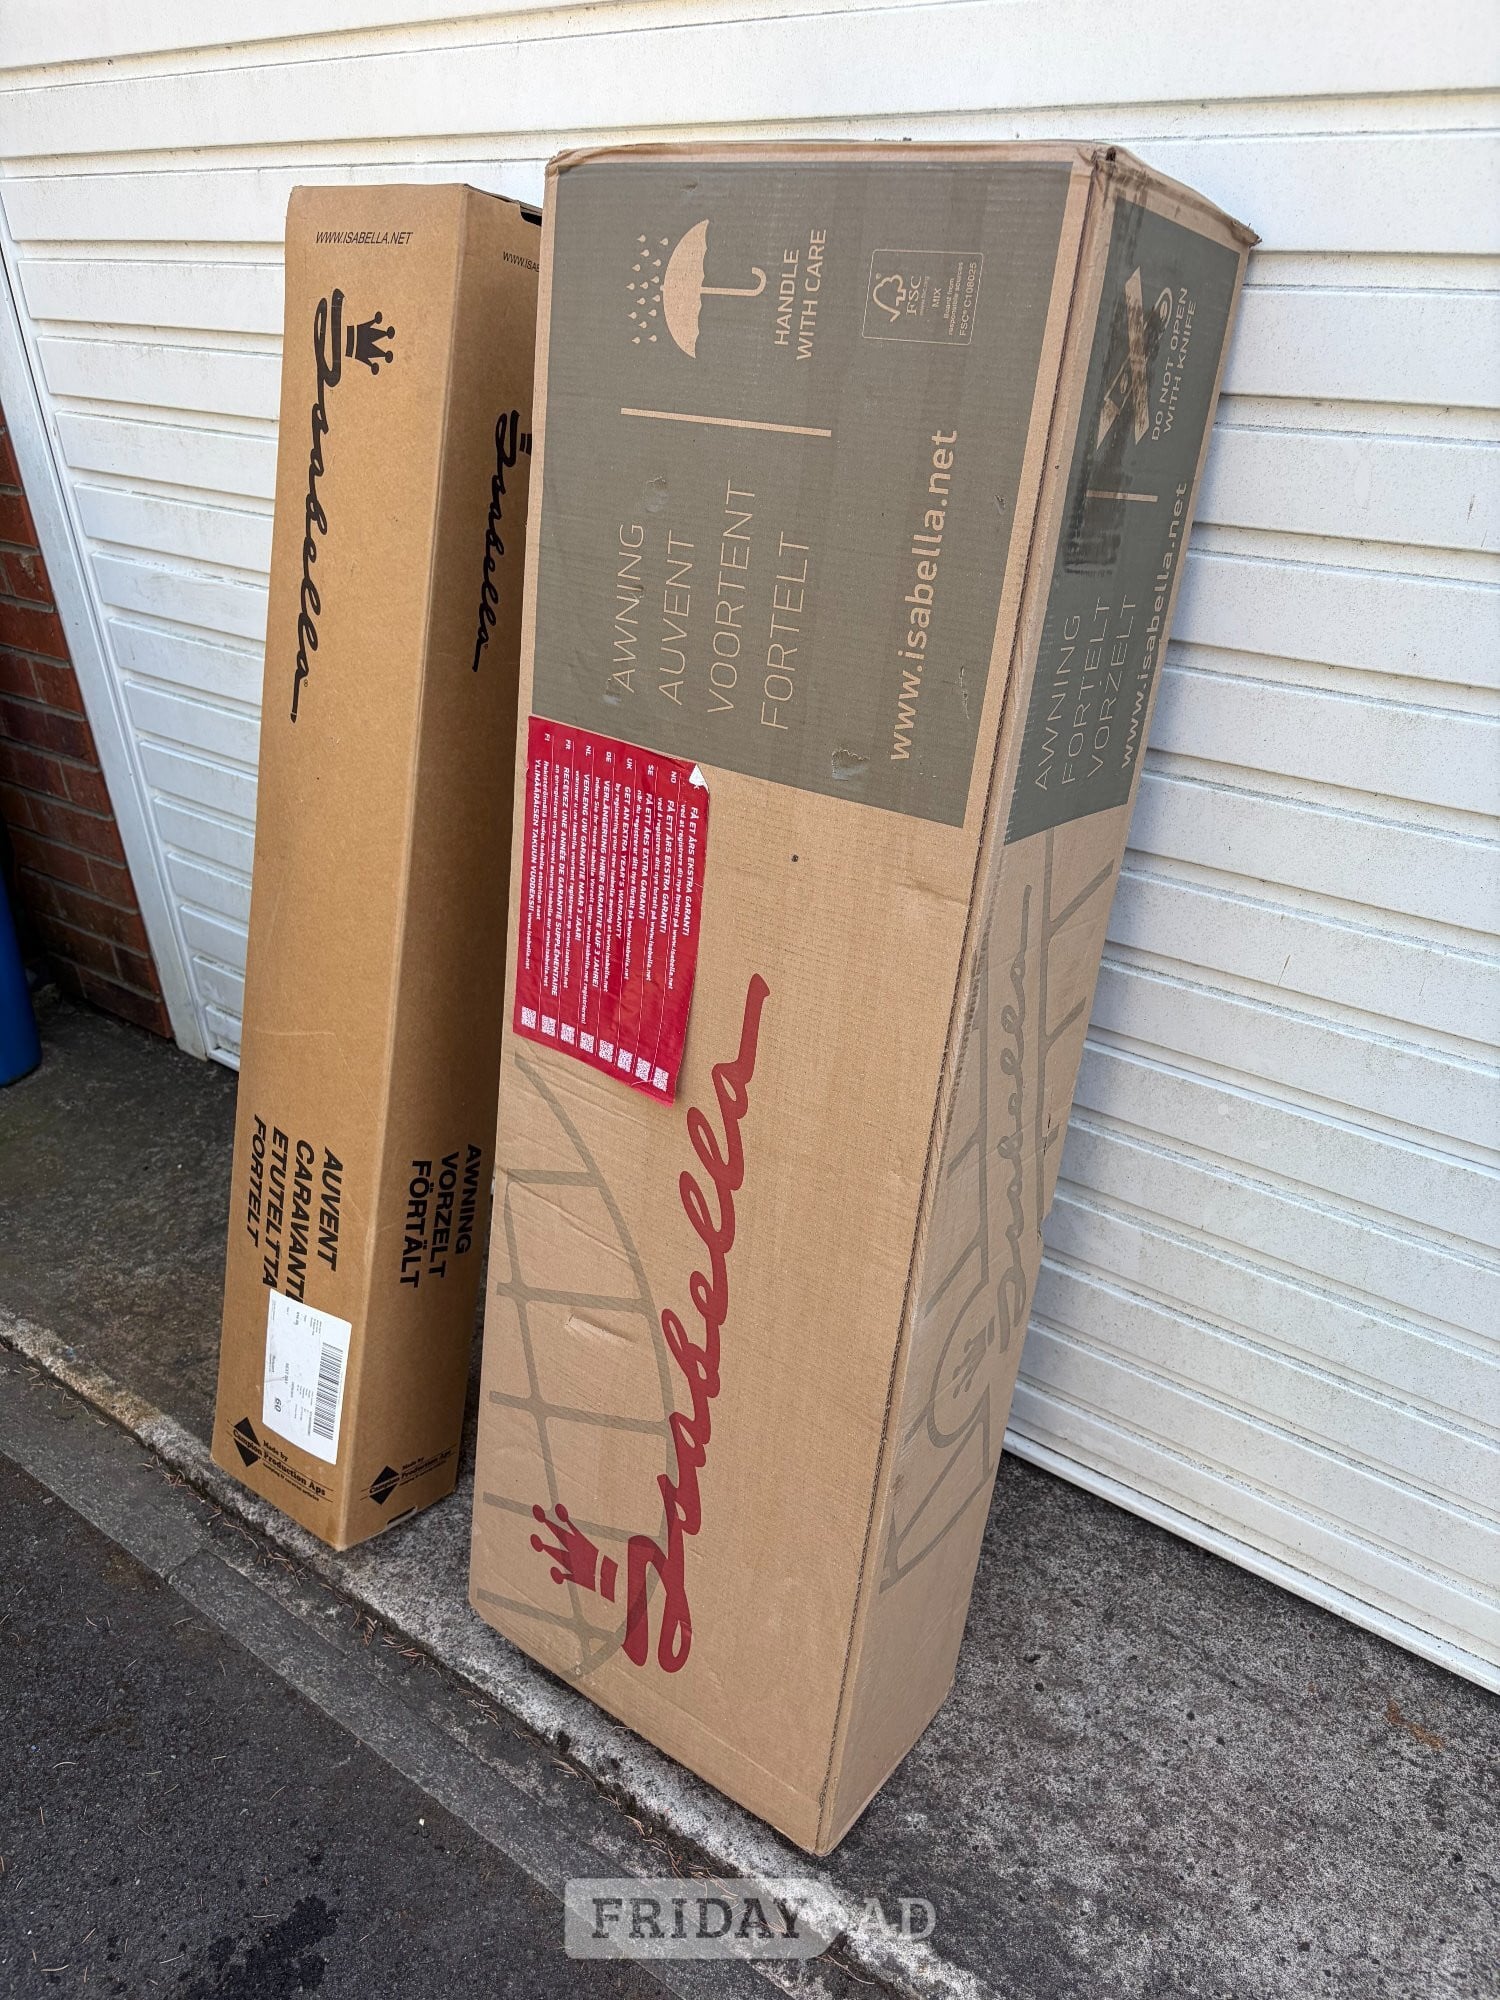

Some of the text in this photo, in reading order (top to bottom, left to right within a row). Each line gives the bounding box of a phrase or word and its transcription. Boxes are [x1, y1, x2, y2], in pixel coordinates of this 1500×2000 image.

[315, 231, 414, 245] WWW.ISABELLA.NET
[774, 249, 800, 346] HANDLE
[797, 228, 828, 361] WITH CARE
[906, 275, 922, 317] FSC
[931, 287, 941, 309] MIX
[963, 261, 977, 309] C108025
[1151, 287, 1188, 441] DO NOT OPEN
[1163, 301, 1196, 433] WITH KNIFE
[290, 288, 345, 724] Isabella
[473, 410, 523, 673] Isabella
[613, 523, 645, 694] AWNING
[658, 529, 696, 707] AUVENT
[707, 479, 756, 714] VOORTENT
[890, 429, 958, 761] www.isabella.net
[760, 531, 810, 731] FORTELT
[1121, 481, 1188, 770] www.isabella.net
[1035, 614, 1082, 791] AWNING
[1061, 596, 1111, 785] FORTELT
[1087, 594, 1136, 779] VORZELT
[544, 733, 550, 741] FI
[565, 739, 571, 750] FR
[585, 745, 591, 756] NL
[605, 751, 611, 763] DE
[626, 757, 632, 770] UK
[532, 759, 541, 826] YLIMÄÄRÄISEN
[581, 774, 590, 815] VERLENG
[614, 782, 621, 792] by
[645, 792, 653, 805] FÅ
[647, 764, 654, 776] SE
[670, 770, 677, 783] NO
[581, 817, 588, 834] UW
[600, 780, 610, 853] VERLÄNGERUNG
[621, 822, 629, 851] EXTRA
[623, 805, 630, 820] AN
[642, 826, 651, 846] ÅRS
[679, 819, 685, 828] at
[558, 862, 565, 875] DE
[559, 830, 567, 861] ANNÉE
[578, 835, 587, 880] GARANTIE
[598, 855, 606, 883] IHRER
[618, 855, 626, 887] YEAR'S
[641, 847, 649, 877] EXTRA
[659, 799, 675, 933] FÅ ETT ÅRS EKSTRA GARANTI
[682, 806, 699, 935] FÅ ET ÅRS EKSTRA GARANTI
[555, 876, 564, 920] GARANTIE
[595, 884, 604, 928] GARANTIE
[615, 889, 624, 938] WARRANTY
[638, 879, 647, 919] GARANTI
[583, 924, 591, 982] www.isabella.net
[607, 924, 612, 933] at
[624, 920, 632, 979] www.isabella.net
[646, 921, 655, 981] www.isabella.net
[551, 921, 561, 996] SUPPLÉMENTAIRE
[603, 934, 611, 992] www.isabella.net
[668, 929, 677, 989] www.isabella.net
[246, 1114, 267, 1248] FORTELT
[263, 1126, 289, 1291] ETUTELTTA
[317, 1147, 344, 1272] AUVENT
[455, 1144, 482, 1255] AWNING
[400, 1160, 433, 1289] FÖRTÄLT
[428, 1152, 460, 1279] VORZELT
[622, 972, 771, 1674] Isabella
[274, 1397, 281, 1413] 60
[233, 1429, 326, 1496] Campion Production Aps
[263, 1440, 289, 1462] Made by
